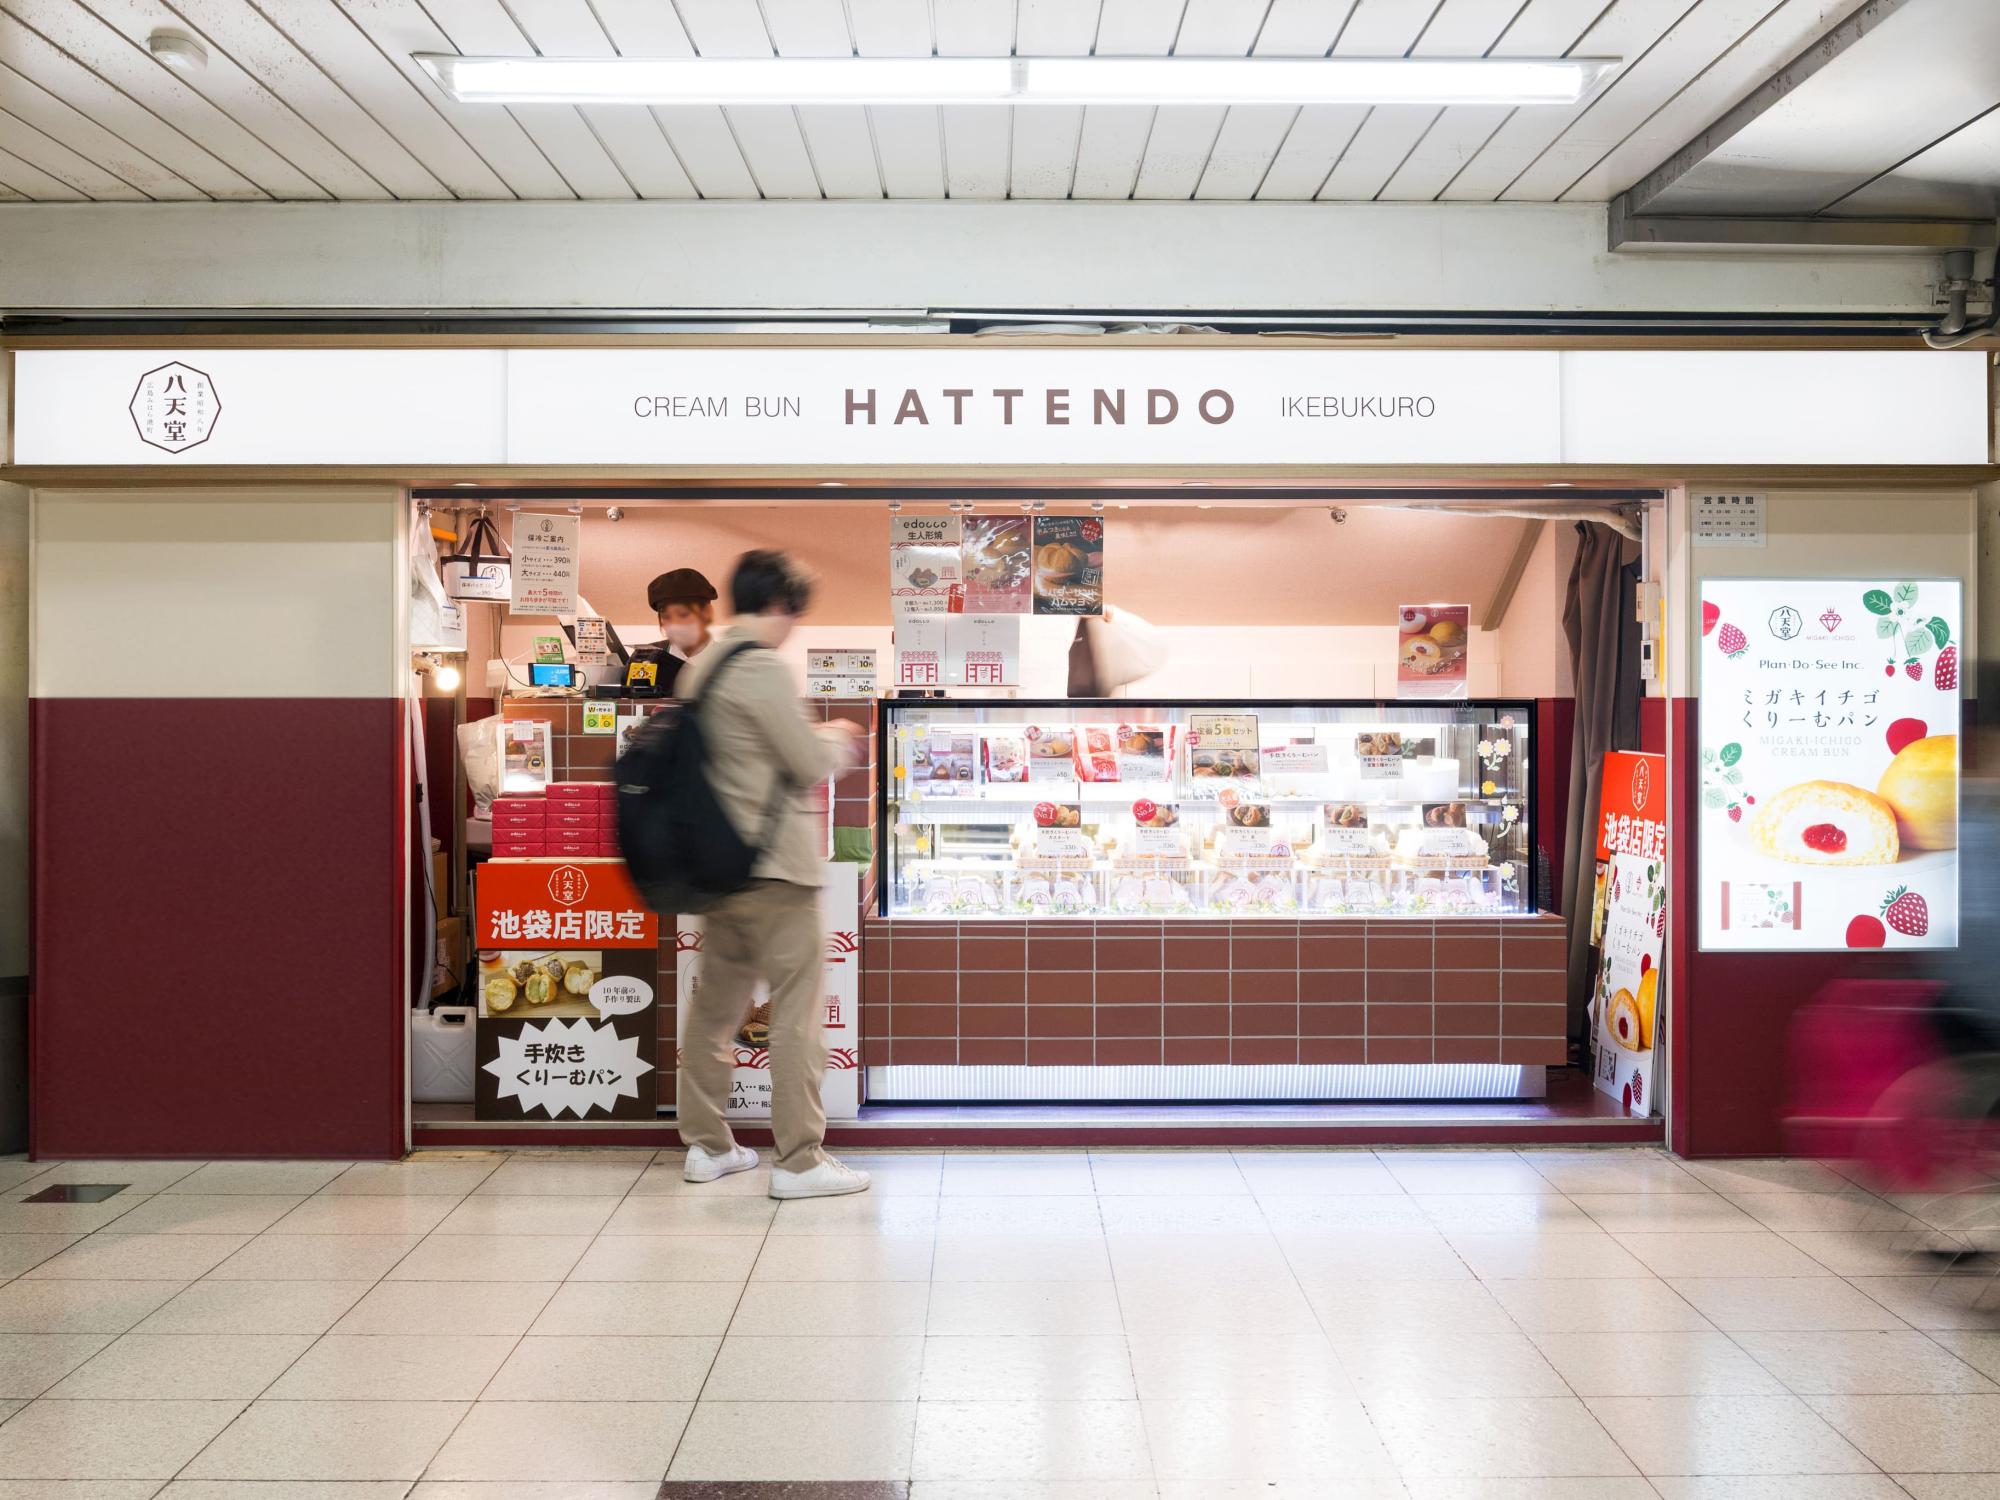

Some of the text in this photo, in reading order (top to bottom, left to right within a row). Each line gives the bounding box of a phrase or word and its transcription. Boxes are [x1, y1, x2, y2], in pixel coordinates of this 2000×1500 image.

[163, 374, 187, 441] 八天堂
[634, 388, 1436, 425] CREAM BUN HATTENDO IKEBUKURO
[1703, 496, 1754, 505] 営業時間
[903, 518, 948, 529] edocco
[907, 531, 943, 541] 生人形焼
[1779, 609, 1791, 637] 八天堂
[1743, 688, 1880, 706] ミガキイチゴ
[1743, 710, 1879, 728] くりーむパン
[1772, 747, 1851, 757] CREAM BUN
[1603, 811, 1666, 862] 池袋店限定
[562, 871, 574, 901] 八天堂
[490, 909, 646, 941] 池袋店限定
[524, 1043, 586, 1064] 手炊き
[516, 1069, 622, 1086] くりーむパン
